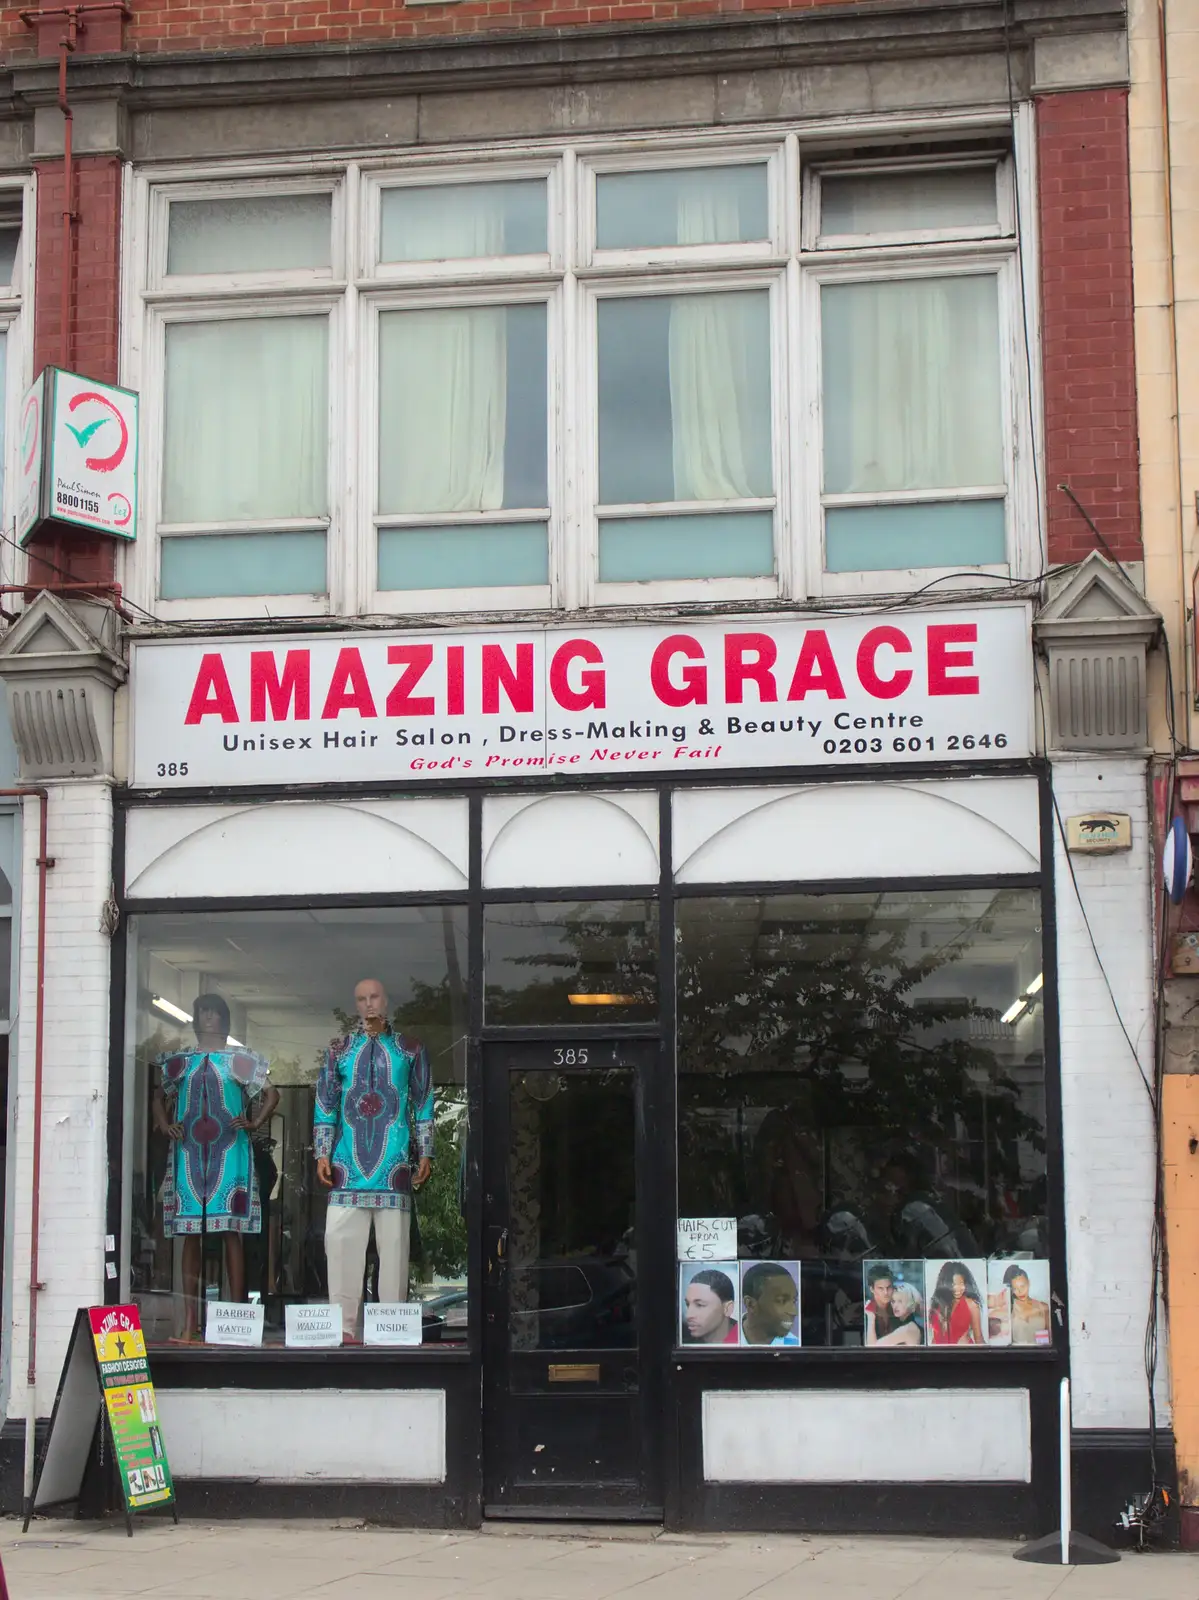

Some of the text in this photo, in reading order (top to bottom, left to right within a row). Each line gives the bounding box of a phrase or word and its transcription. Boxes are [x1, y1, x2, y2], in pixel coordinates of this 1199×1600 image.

[184, 624, 980, 725] AMAZING GRACE
[223, 734, 312, 752] Unisex
[323, 730, 379, 748] Hair
[396, 728, 471, 746] Salon
[499, 720, 687, 744] Dress-Making
[699, 718, 716, 736] &
[727, 716, 822, 738] Beauty
[833, 712, 924, 730] Centre
[823, 733, 1009, 754] 0203 601 2646
[410, 745, 723, 770] God's Promise Never Fail
[157, 762, 189, 777] 385
[553, 1048, 589, 1065] 385
[677, 1219, 737, 1233] HAIR CUT
[689, 1232, 719, 1241] FROM
[215, 1308, 256, 1319] BARBER
[297, 1308, 331, 1318] STYLIST
[366, 1307, 420, 1316] WE SEW THEM
[217, 1323, 252, 1334] WANTED
[296, 1321, 332, 1331] WANTED
[376, 1323, 408, 1332] INSIDE
